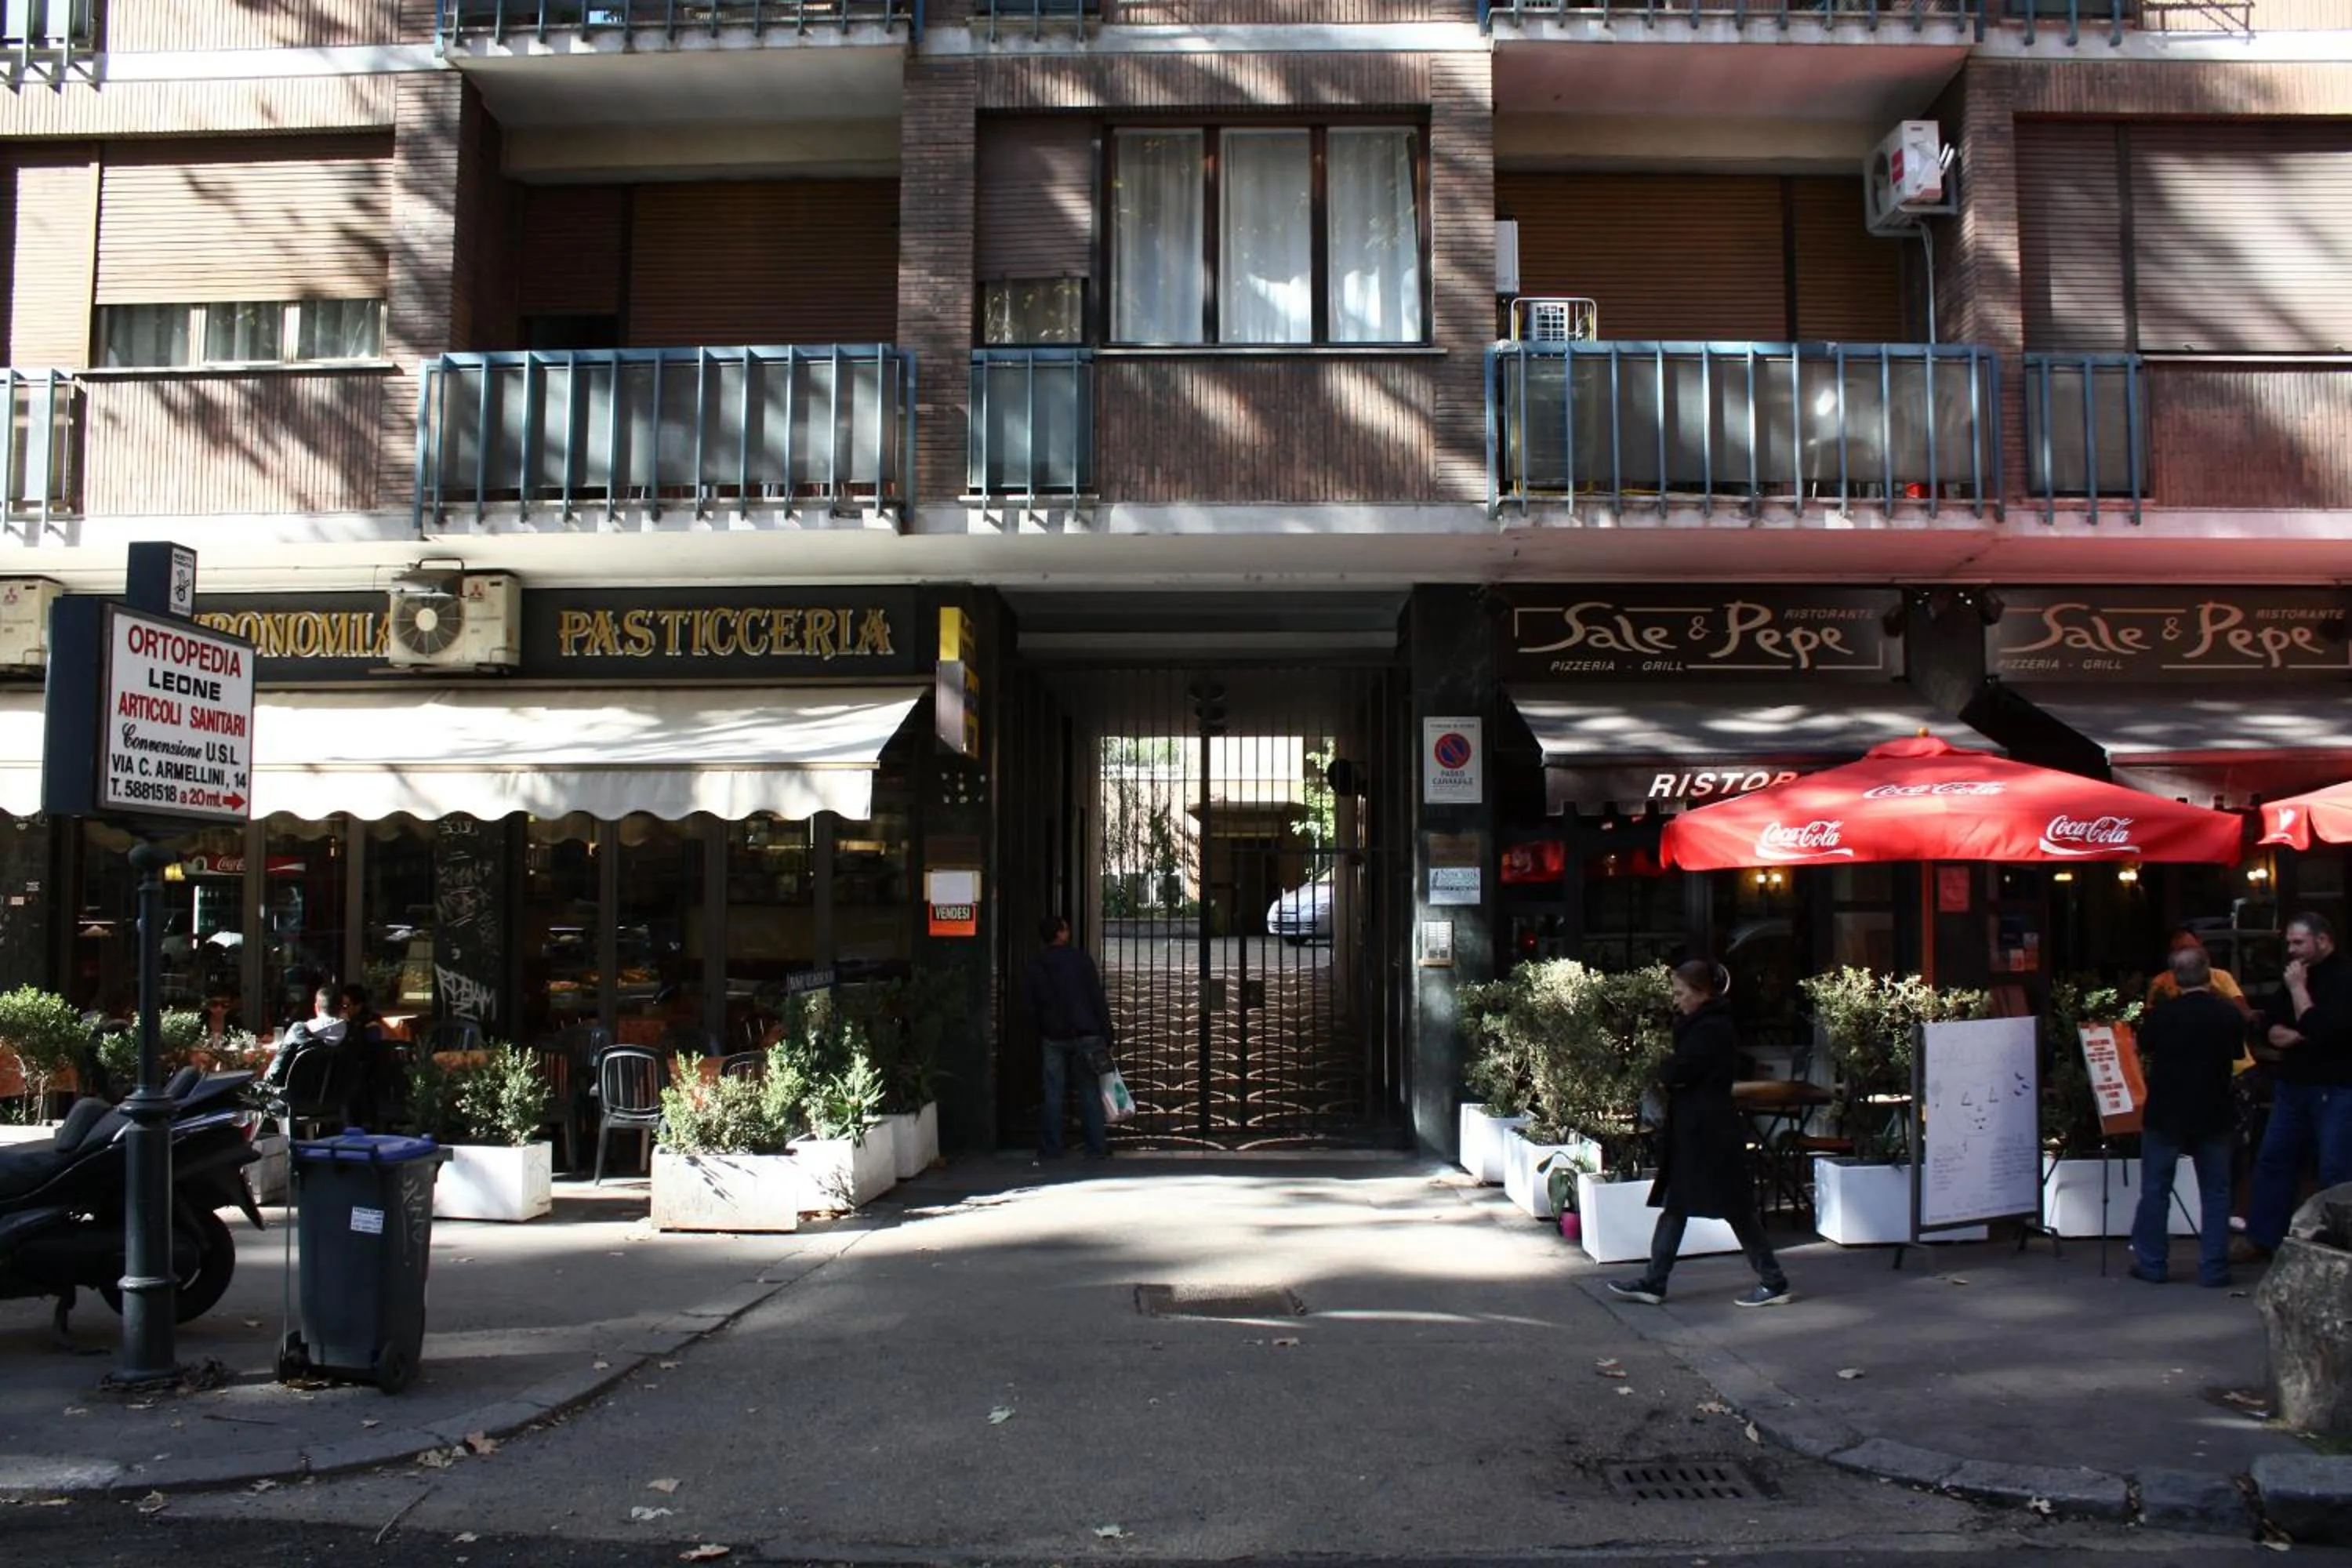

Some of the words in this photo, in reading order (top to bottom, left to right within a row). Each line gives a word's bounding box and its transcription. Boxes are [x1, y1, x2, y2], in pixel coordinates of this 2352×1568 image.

[1784, 609, 1876, 619] RISTORANTE
[2256, 608, 2347, 620] RISTORANTE
[560, 608, 895, 661] PASTICCERIA
[1517, 601, 1678, 655] Sale
[1688, 615, 1711, 640] &
[1708, 600, 1854, 668] Pepe
[1998, 602, 2153, 655] Sale
[2161, 616, 2183, 641] &
[2182, 600, 2325, 667] Pepe
[128, 624, 241, 678] ORTOPEDIA
[1998, 659, 2060, 670] PIZZERIA
[2082, 659, 2123, 670] GRILL
[1550, 661, 1615, 671] PIZZERIA
[1642, 661, 1684, 671] GRILL
[148, 668, 222, 702] LEONE
[118, 691, 181, 725] ARTICOLI
[190, 706, 245, 738] SANITARI
[122, 722, 203, 759] Convenzione
[111, 753, 134, 774] VIA
[139, 757, 152, 777] C.
[234, 772, 247, 789] 14
[111, 778, 122, 797] T.
[125, 780, 176, 803] 5881518
[180, 791, 187, 804] a
[189, 788, 206, 807] 20
[1862, 781, 2007, 800] Coca-Cola
[1761, 820, 1844, 848] Coca-Cola
[2046, 815, 2134, 844] Coca-Cola
[935, 906, 971, 920] VENDESI
